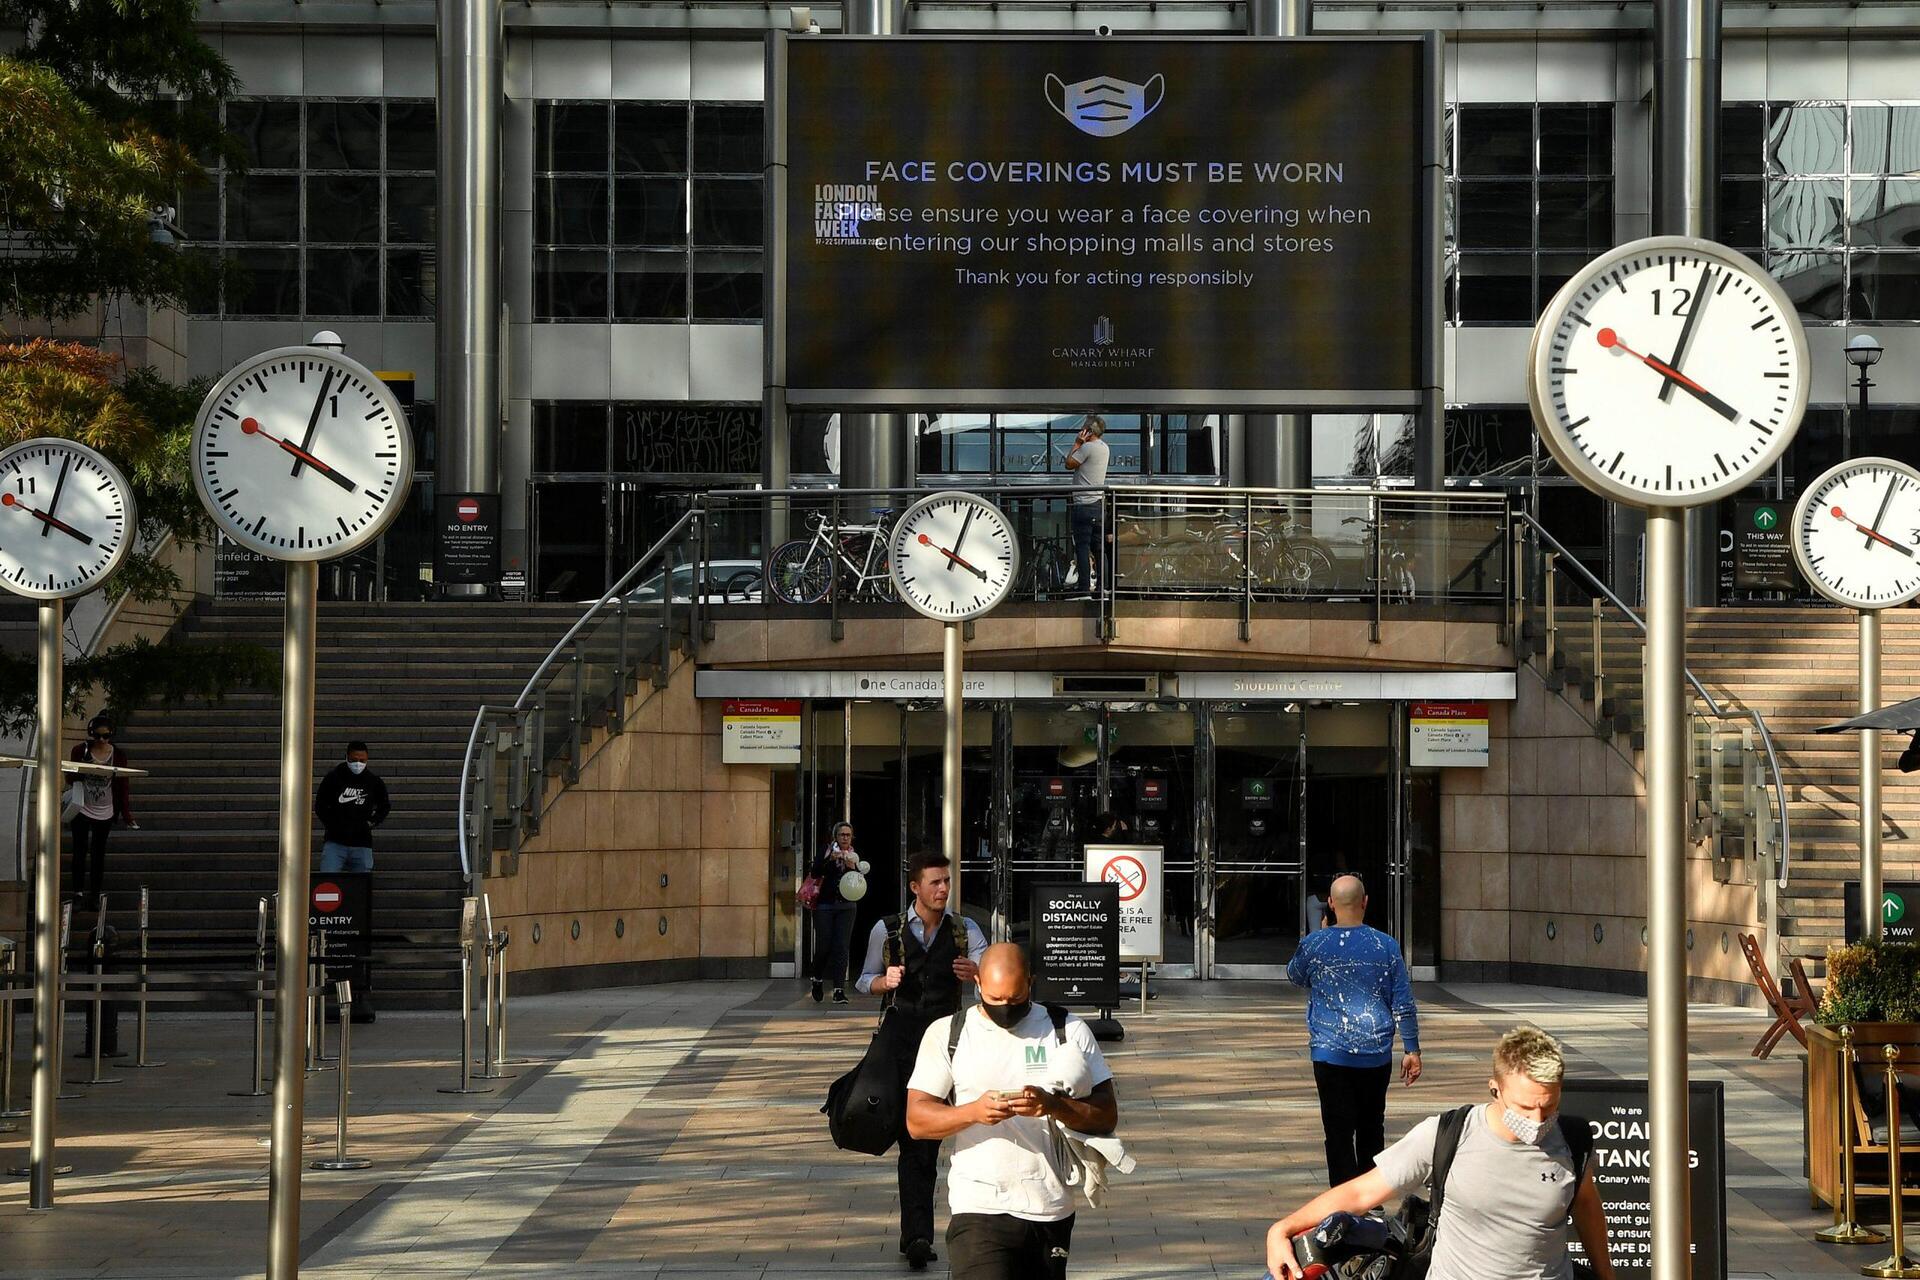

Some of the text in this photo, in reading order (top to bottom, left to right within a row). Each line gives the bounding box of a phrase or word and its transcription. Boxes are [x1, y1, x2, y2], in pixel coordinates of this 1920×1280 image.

[866, 161, 1344, 183] FACE COVERINGS MUST BE WORN
[815, 184, 878, 202] LONDON
[815, 202, 882, 220] FASHION
[840, 203, 1371, 227] Please ensure you wear a face covering when
[815, 221, 860, 238] WEEK
[834, 238, 867, 246] SEPTEMBER
[875, 233, 1334, 255] entering our shopping malls and stores
[955, 268, 1254, 288] Thank you for acting responsibly
[1651, 288, 1691, 317] 12
[1052, 348, 1155, 358] CANARY WHARF
[1071, 360, 1136, 368] MANAGEMENT
[329, 394, 338, 418] 1
[16, 476, 36, 495] 11
[447, 524, 488, 532] NO ENTRY
[1746, 532, 1784, 540] THIS WAY
[1909, 528, 1920, 545] 3
[860, 678, 985, 691] One Canada Sare
[1233, 679, 1343, 691] Shopping Centre
[1049, 900, 1101, 910] SOCIALLY
[1126, 907, 1135, 915] IS
[1137, 907, 1144, 915] A
[319, 916, 353, 925] ENTRY
[1042, 913, 1108, 922] DISTANCING
[1129, 916, 1153, 924] FREE
[1118, 925, 1137, 933] REA
[1891, 927, 1914, 936] WAY
[1025, 1045, 1047, 1063] M
[1611, 1106, 1626, 1115] We
[1598, 1174, 1630, 1185] Canary
[1631, 1174, 1651, 1184] Wha
[1601, 1199, 1651, 1210] cordance
[1617, 1229, 1652, 1238] ensure
[1607, 1242, 1636, 1253] SAFE
[1631, 1257, 1644, 1267] at
